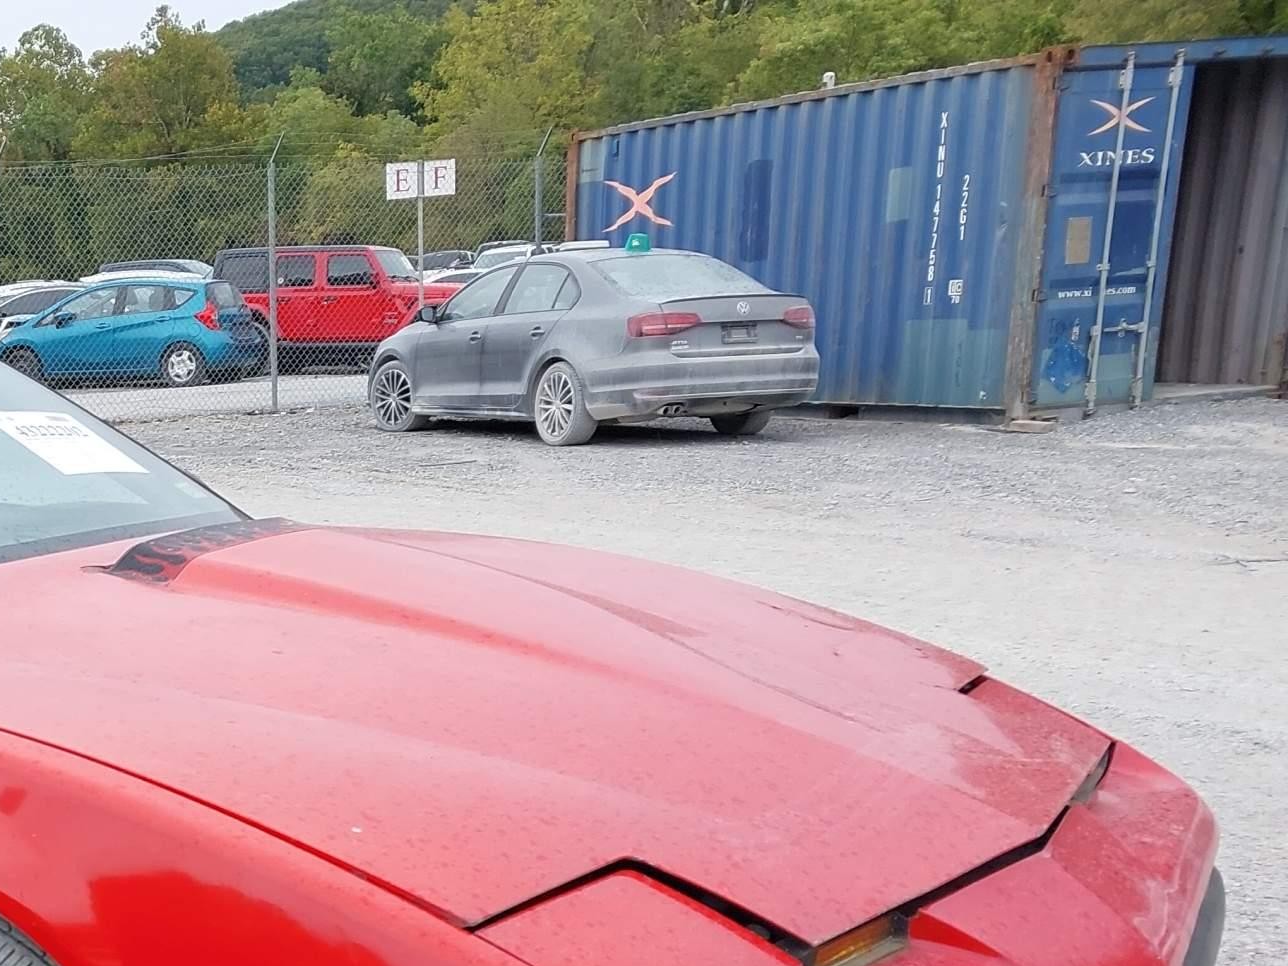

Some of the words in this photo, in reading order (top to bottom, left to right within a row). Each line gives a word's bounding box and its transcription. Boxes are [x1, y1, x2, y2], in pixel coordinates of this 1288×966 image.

[936, 111, 949, 179] XINU
[1078, 147, 1155, 168] XINES
[394, 169, 411, 192] E
[432, 167, 447, 189] F
[959, 174, 971, 241] 22G1
[927, 183, 942, 282] 147758
